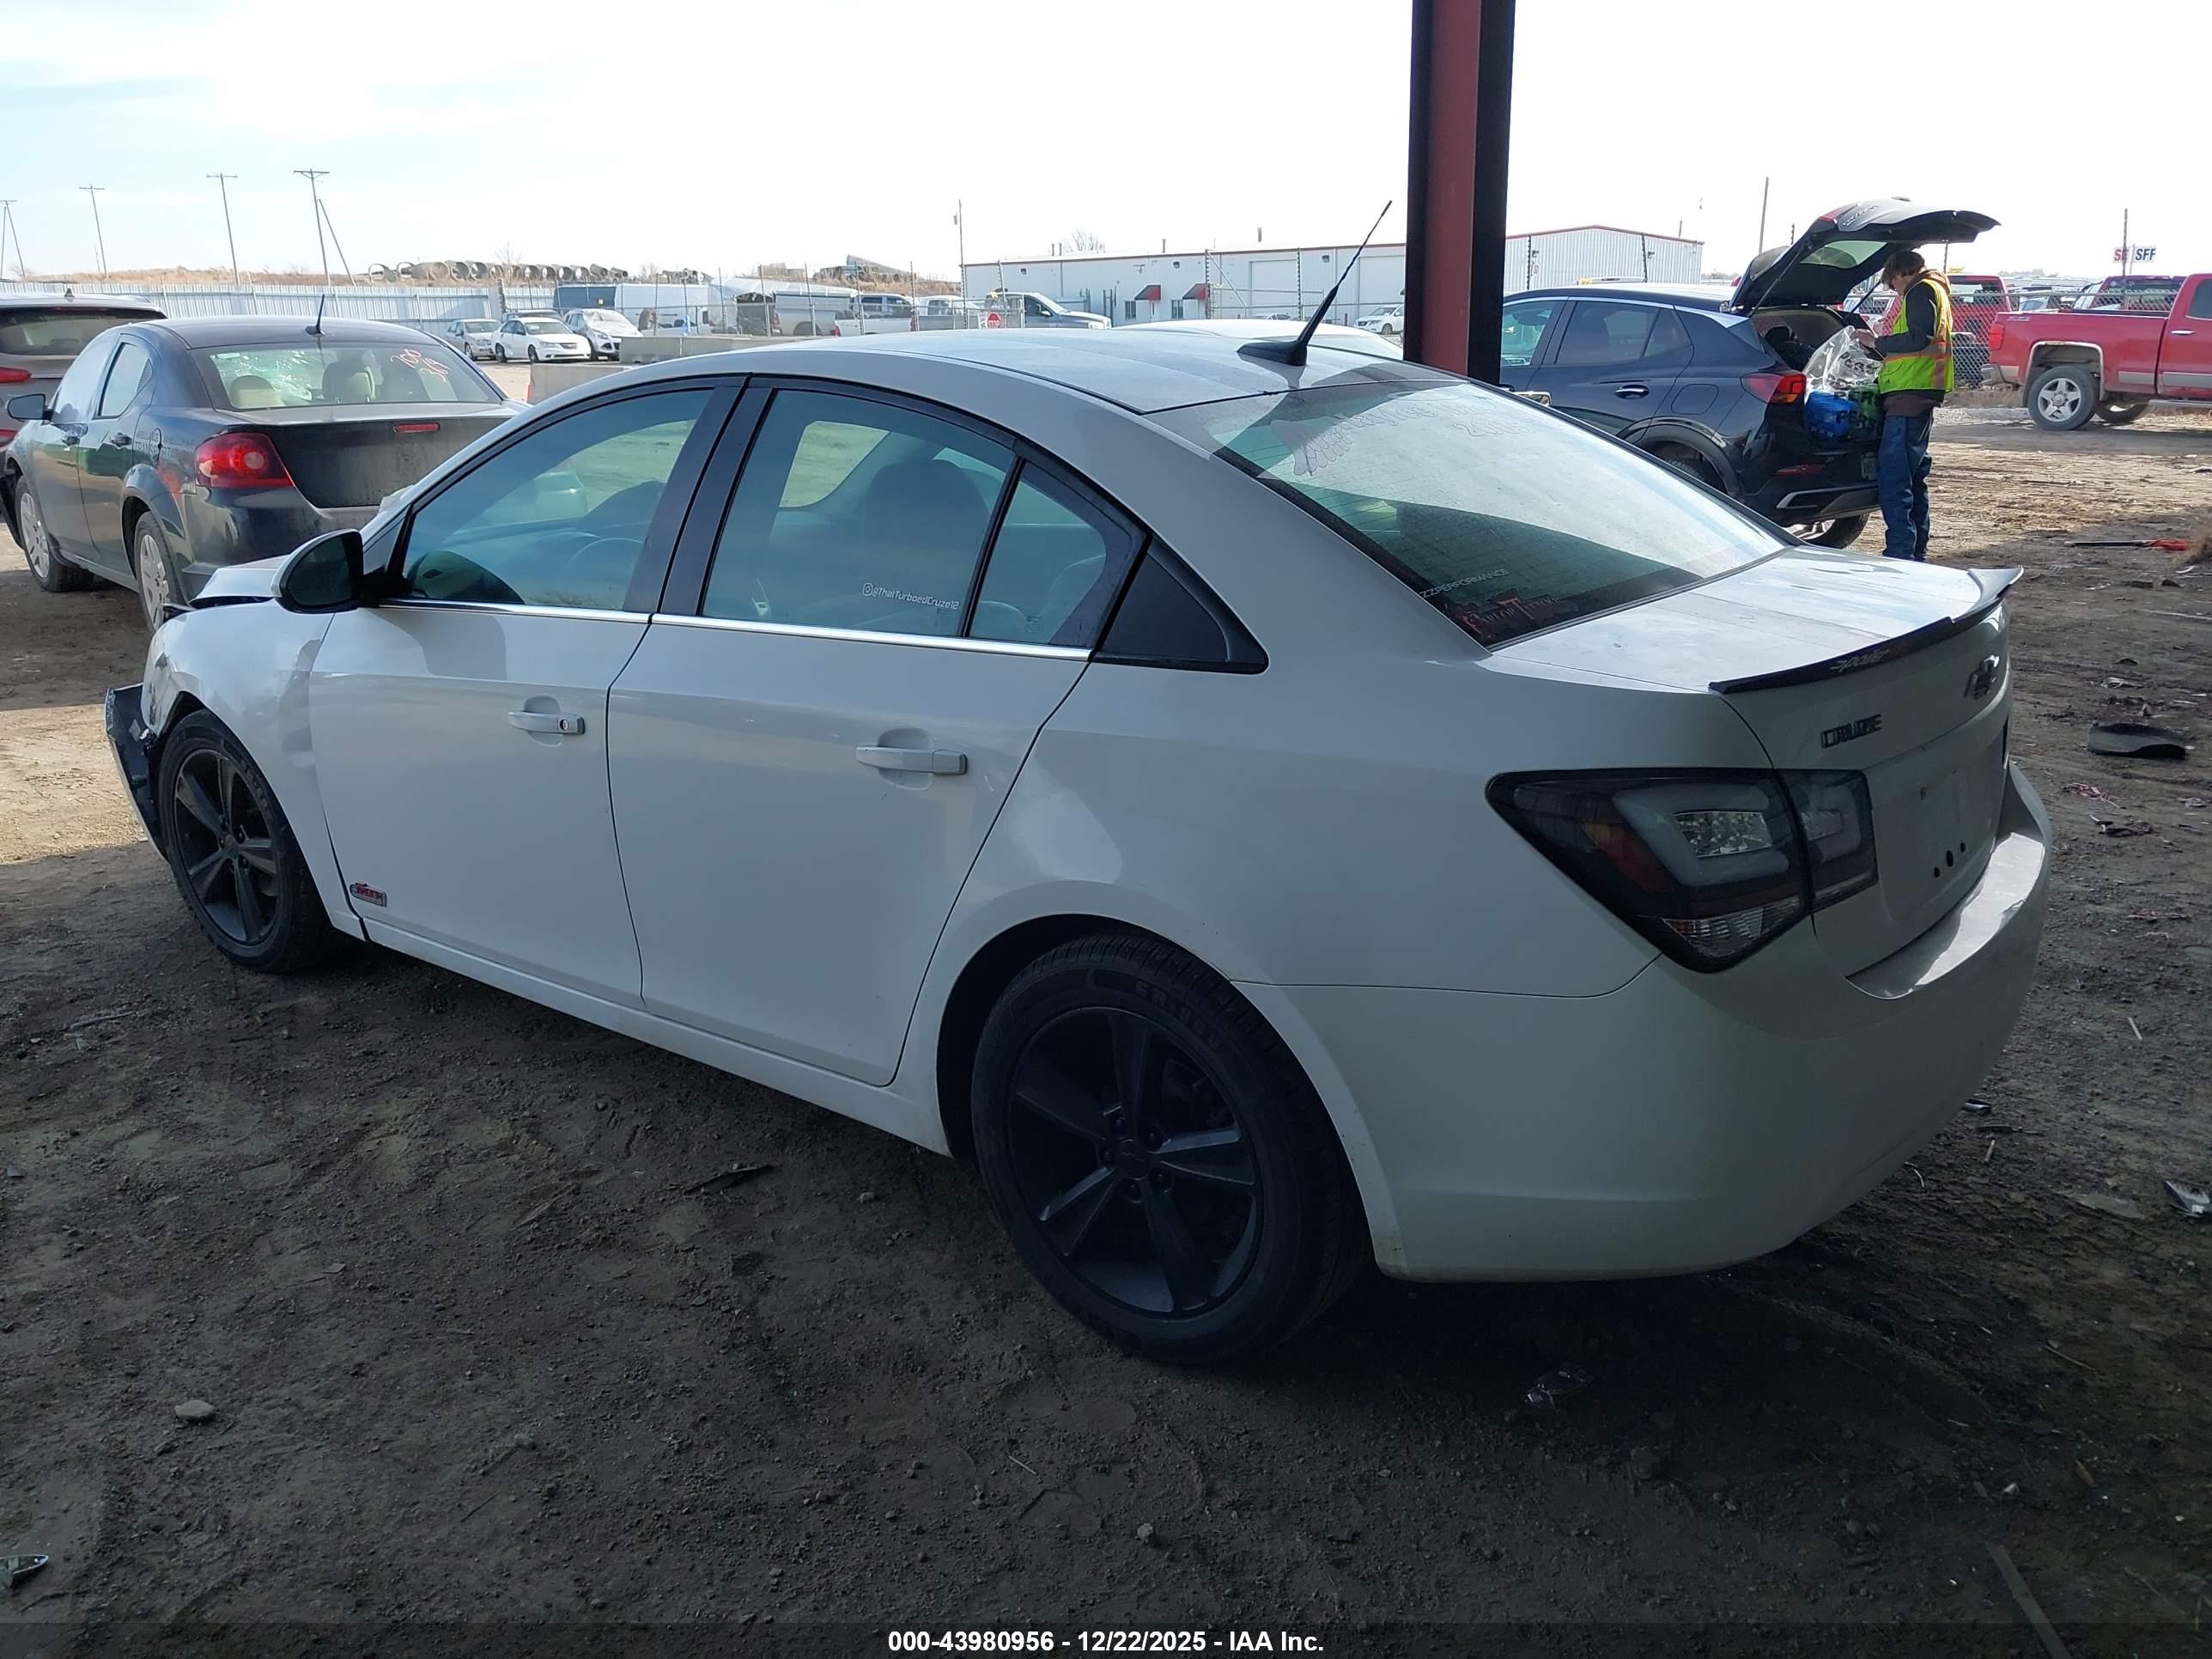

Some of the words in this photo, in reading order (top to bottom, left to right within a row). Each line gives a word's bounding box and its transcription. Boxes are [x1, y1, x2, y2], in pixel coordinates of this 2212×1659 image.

[2135, 248, 2156, 261] SFF
[988, 319, 1001, 330] STOP
[872, 587, 960, 610] @ThatTurboedCruze12
[1821, 714, 1882, 748] CRUZE
